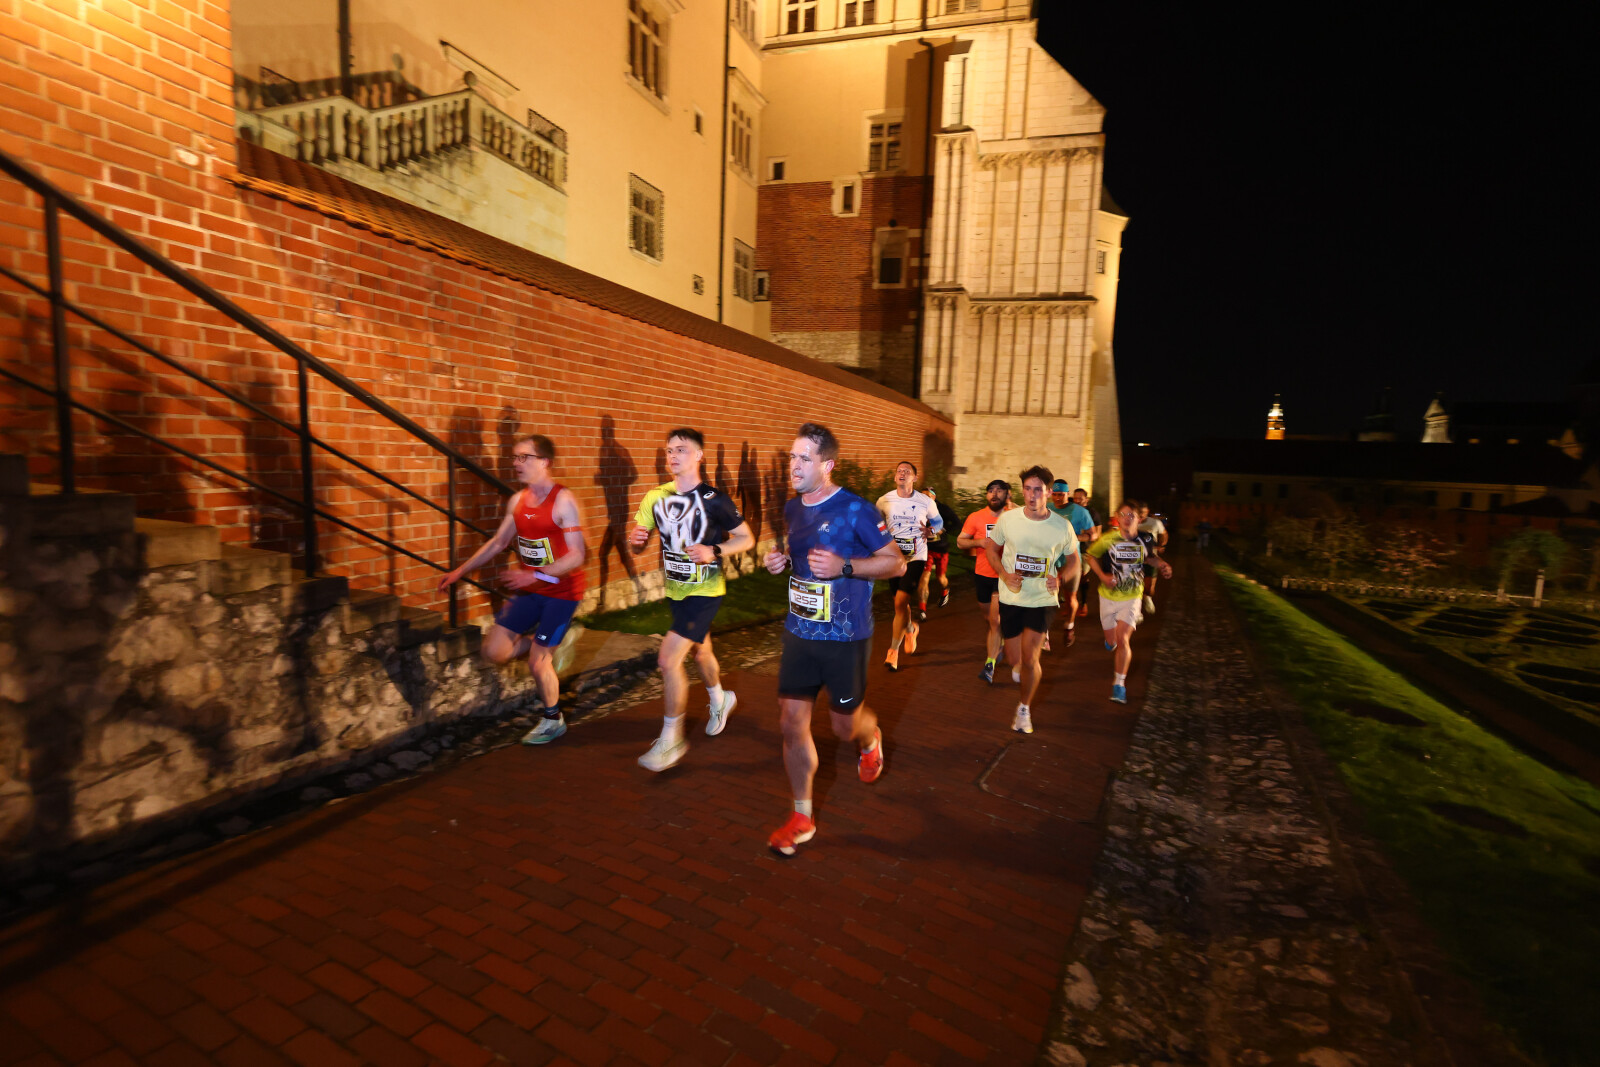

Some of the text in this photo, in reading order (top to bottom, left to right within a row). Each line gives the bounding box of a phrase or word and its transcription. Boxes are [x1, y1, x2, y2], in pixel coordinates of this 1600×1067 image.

[668, 562, 691, 572] 1363
[1019, 563, 1042, 571] 1036
[793, 592, 818, 606] 1252
